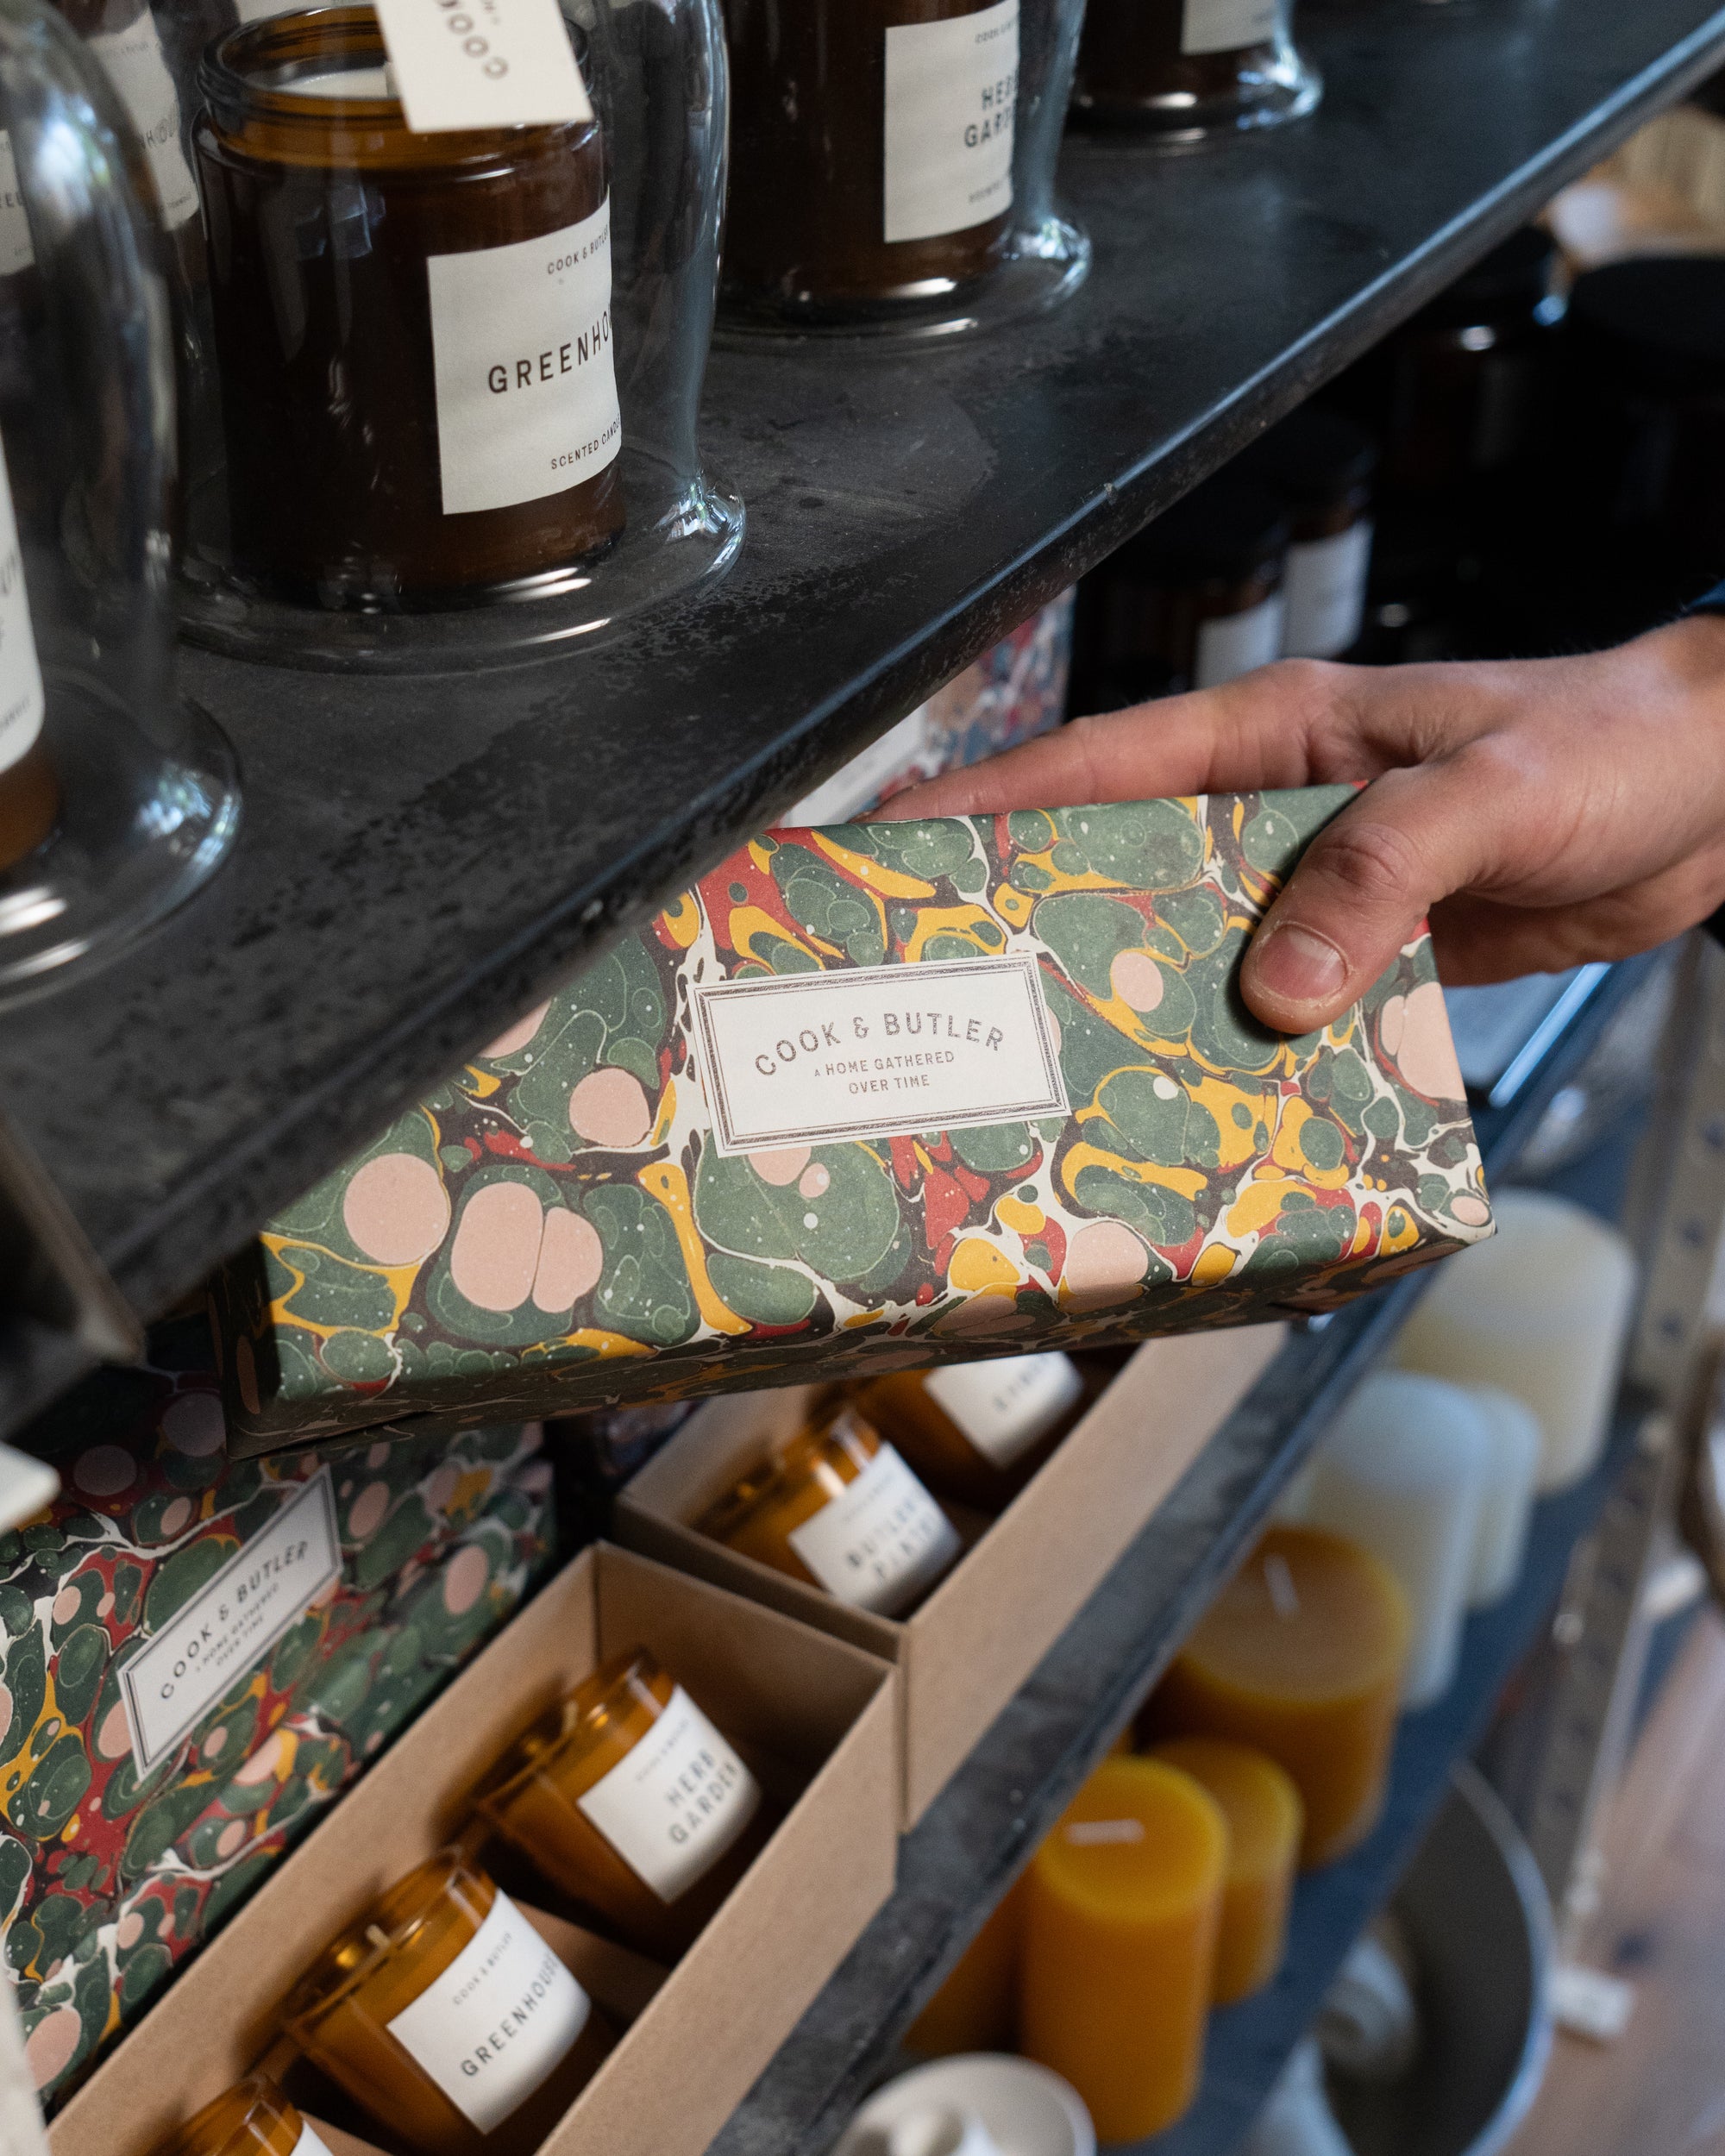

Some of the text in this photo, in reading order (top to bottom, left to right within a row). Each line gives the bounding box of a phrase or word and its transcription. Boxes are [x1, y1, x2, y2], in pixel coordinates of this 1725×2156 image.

[435, 0, 509, 79] COO
[982, 71, 1019, 110] HER
[547, 252, 579, 275] COOK
[582, 247, 587, 260] &
[551, 440, 599, 470] SCENTED
[755, 1012, 1004, 1076] COOK & BUTLER
[814, 1050, 955, 1077] A HOME GATHERED
[849, 1074, 931, 1094] OVER TIME
[160, 1540, 308, 1699] COOK & BUTLER
